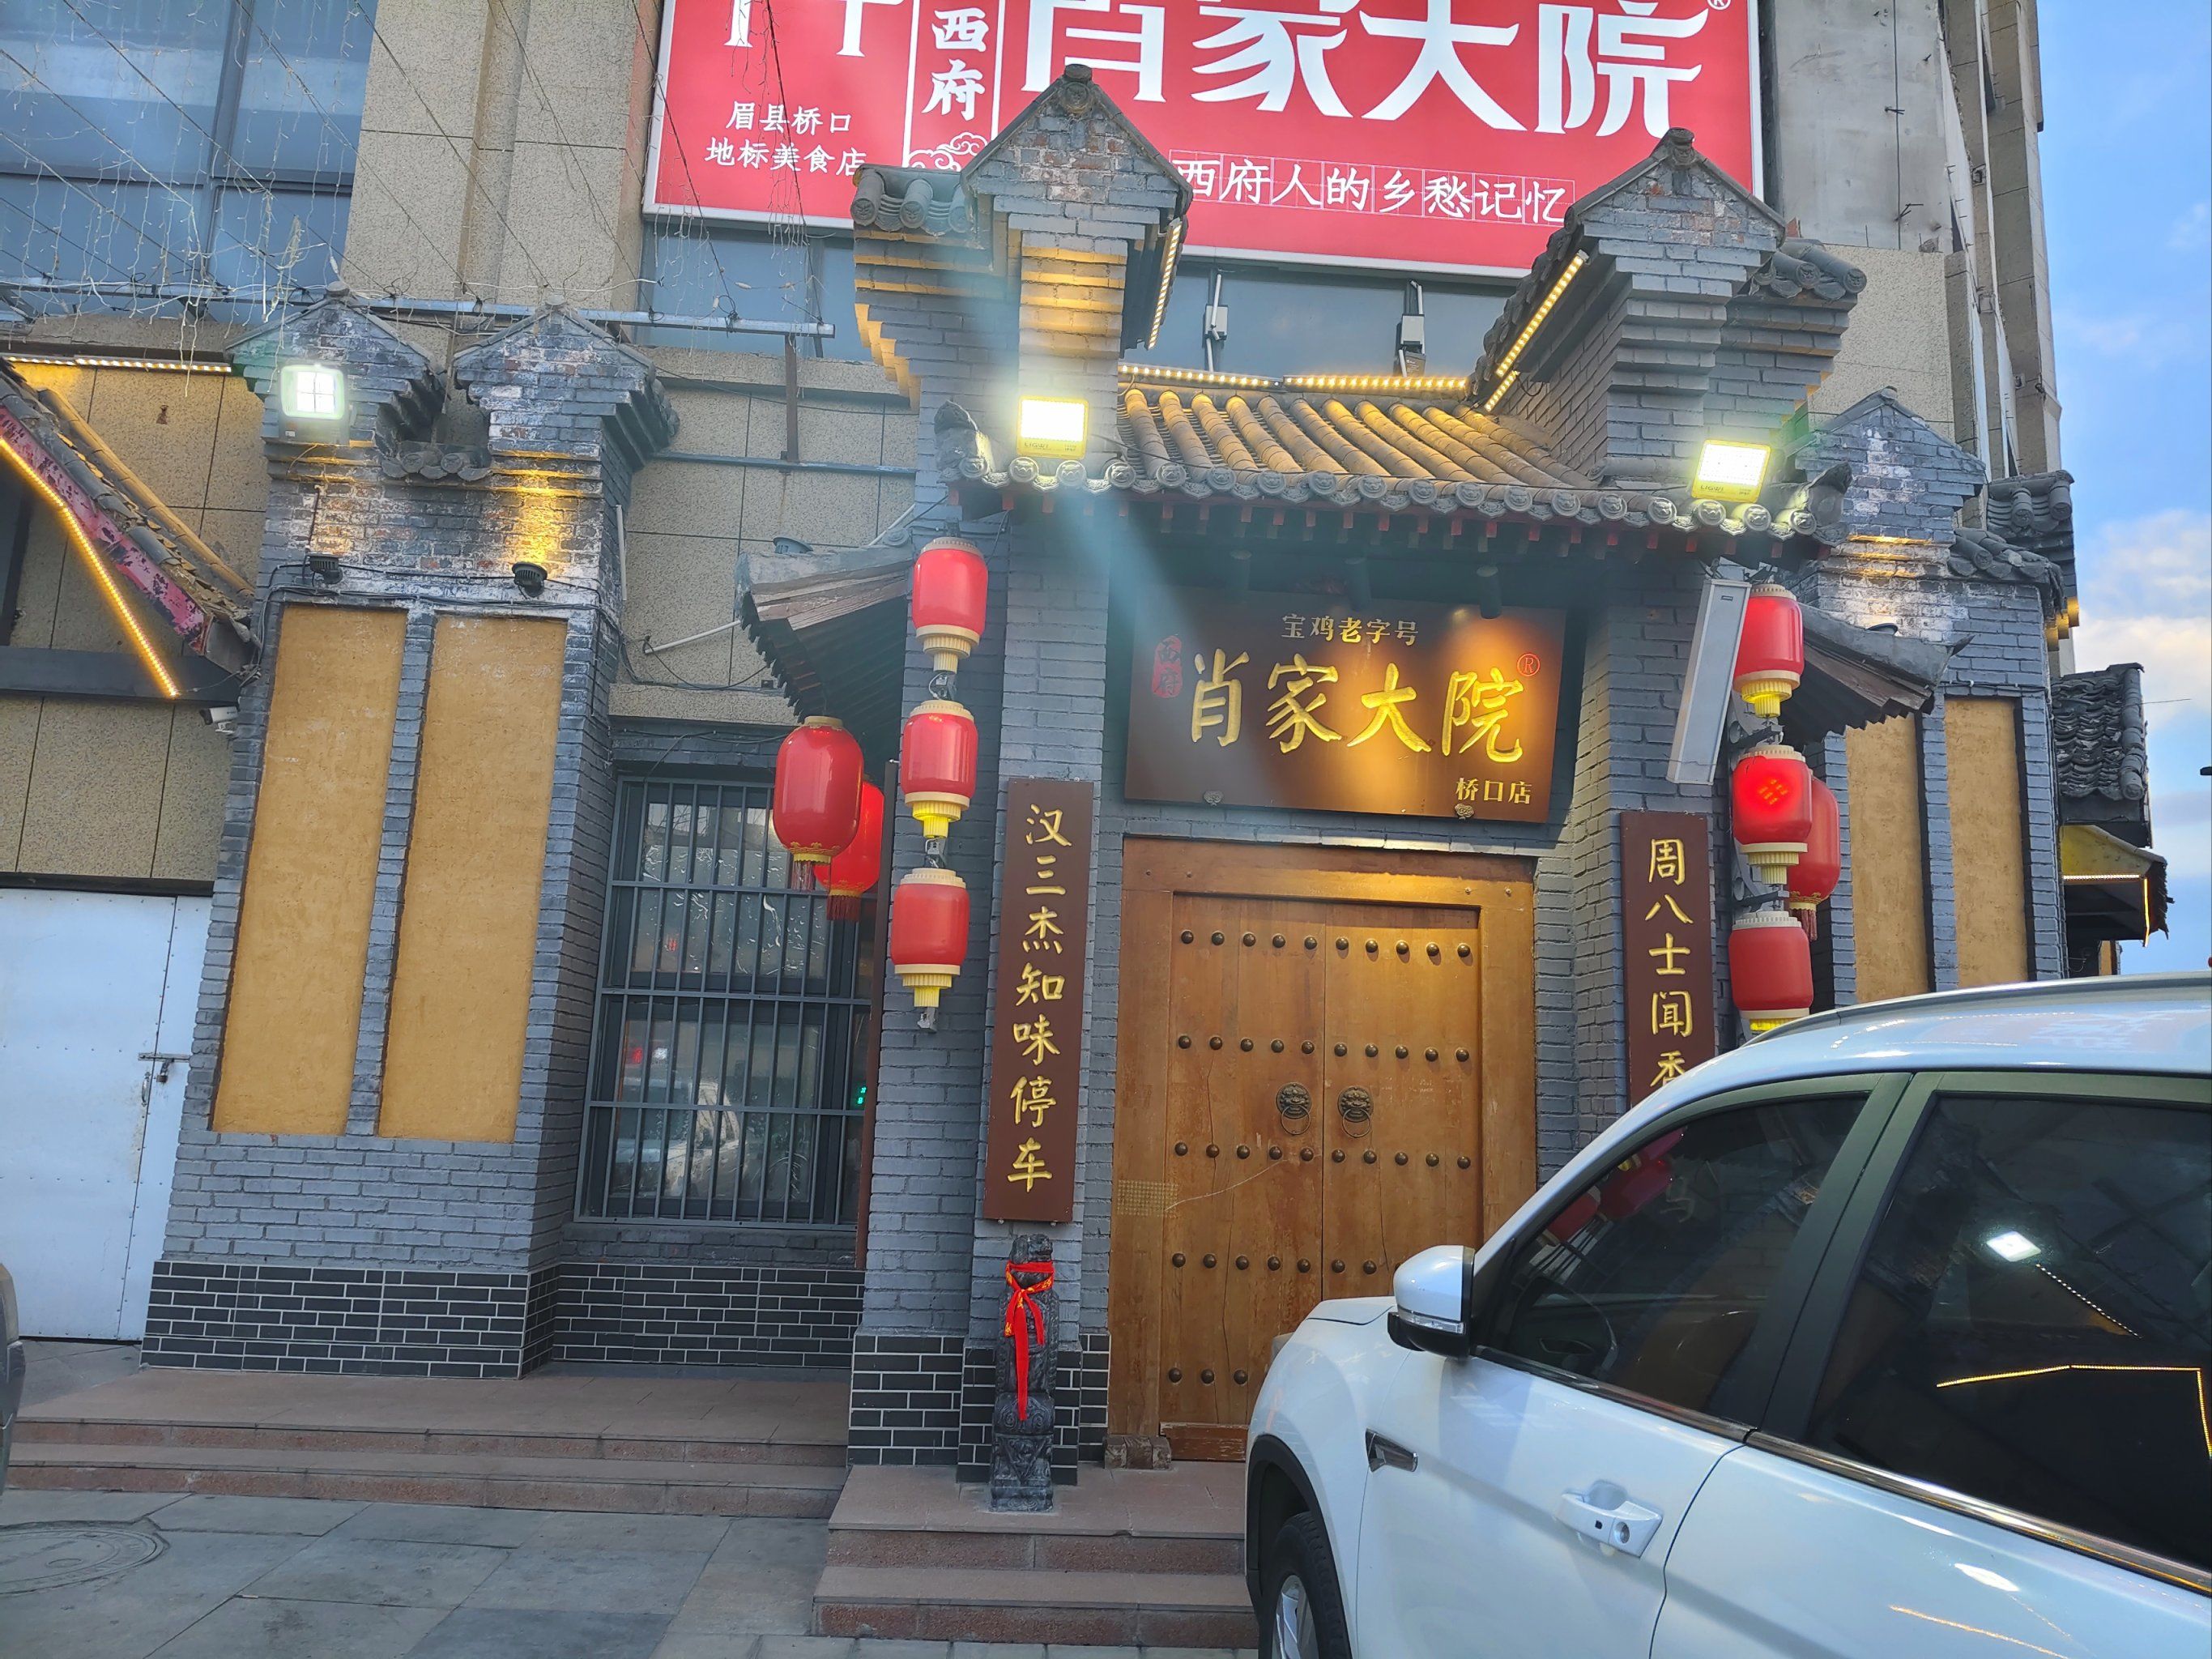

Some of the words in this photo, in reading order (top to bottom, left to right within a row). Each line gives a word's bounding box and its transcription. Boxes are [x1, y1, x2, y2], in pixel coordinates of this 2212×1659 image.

[922, 7, 990, 122] 西府
[1021, 0, 1709, 139] 肖家大院
[726, 100, 852, 136] 眉县桥口
[704, 136, 867, 177] 地标美食店
[1171, 158, 1567, 224] 西府人的乡愁记忆
[1281, 612, 1419, 646] 宝鸡老字号
[1191, 648, 1524, 763] 肖家大院
[1455, 777, 1532, 804] 桥口店
[1007, 803, 1072, 1193] 汉三杰知味停车
